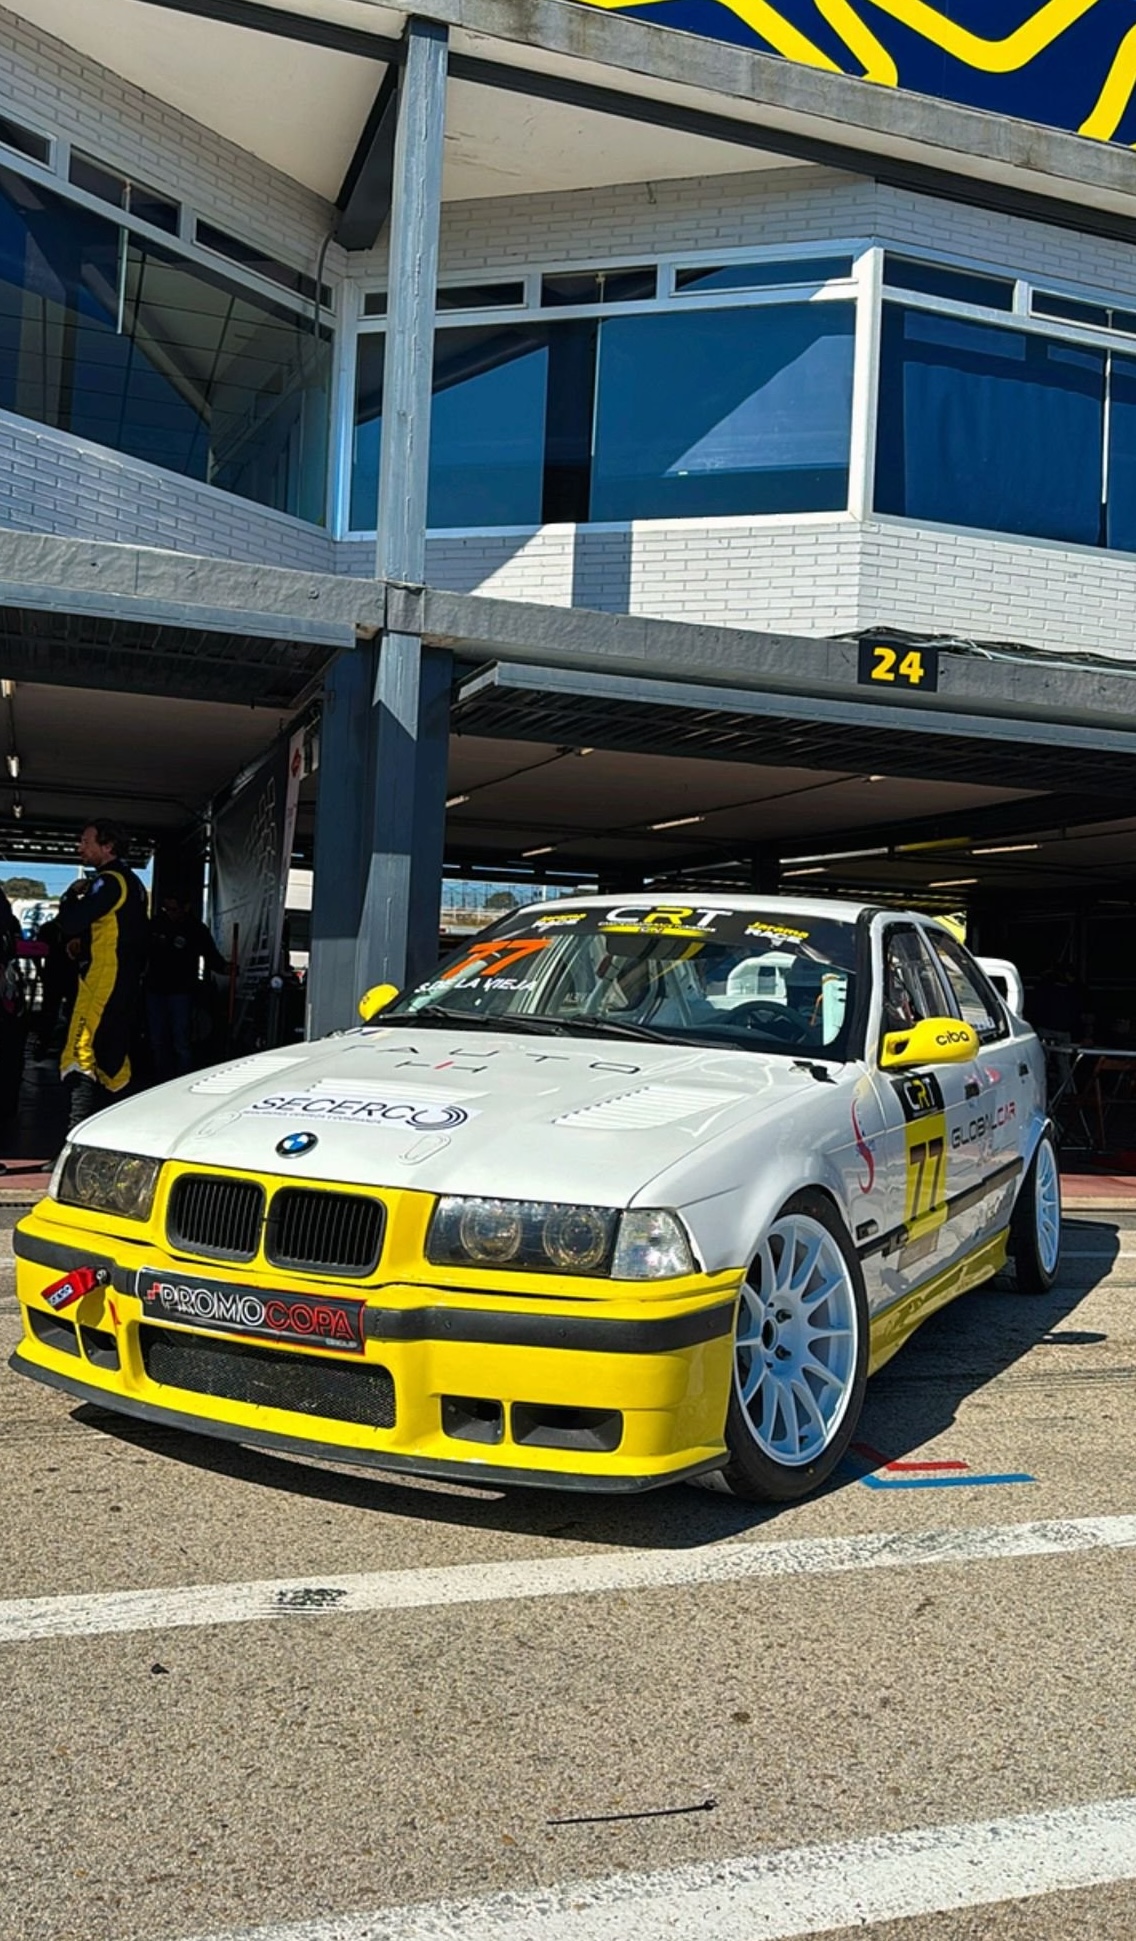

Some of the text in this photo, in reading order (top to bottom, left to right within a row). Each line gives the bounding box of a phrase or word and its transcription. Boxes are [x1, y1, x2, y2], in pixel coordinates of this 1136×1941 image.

[871, 646, 924, 684] 24
[605, 906, 733, 927] CRT
[440, 938, 553, 980] 77
[454, 978, 481, 989] LA
[483, 978, 537, 992] VIEJA
[935, 1030, 970, 1046] ciba
[903, 1077, 936, 1110] CRT
[909, 1136, 944, 1222] 77
